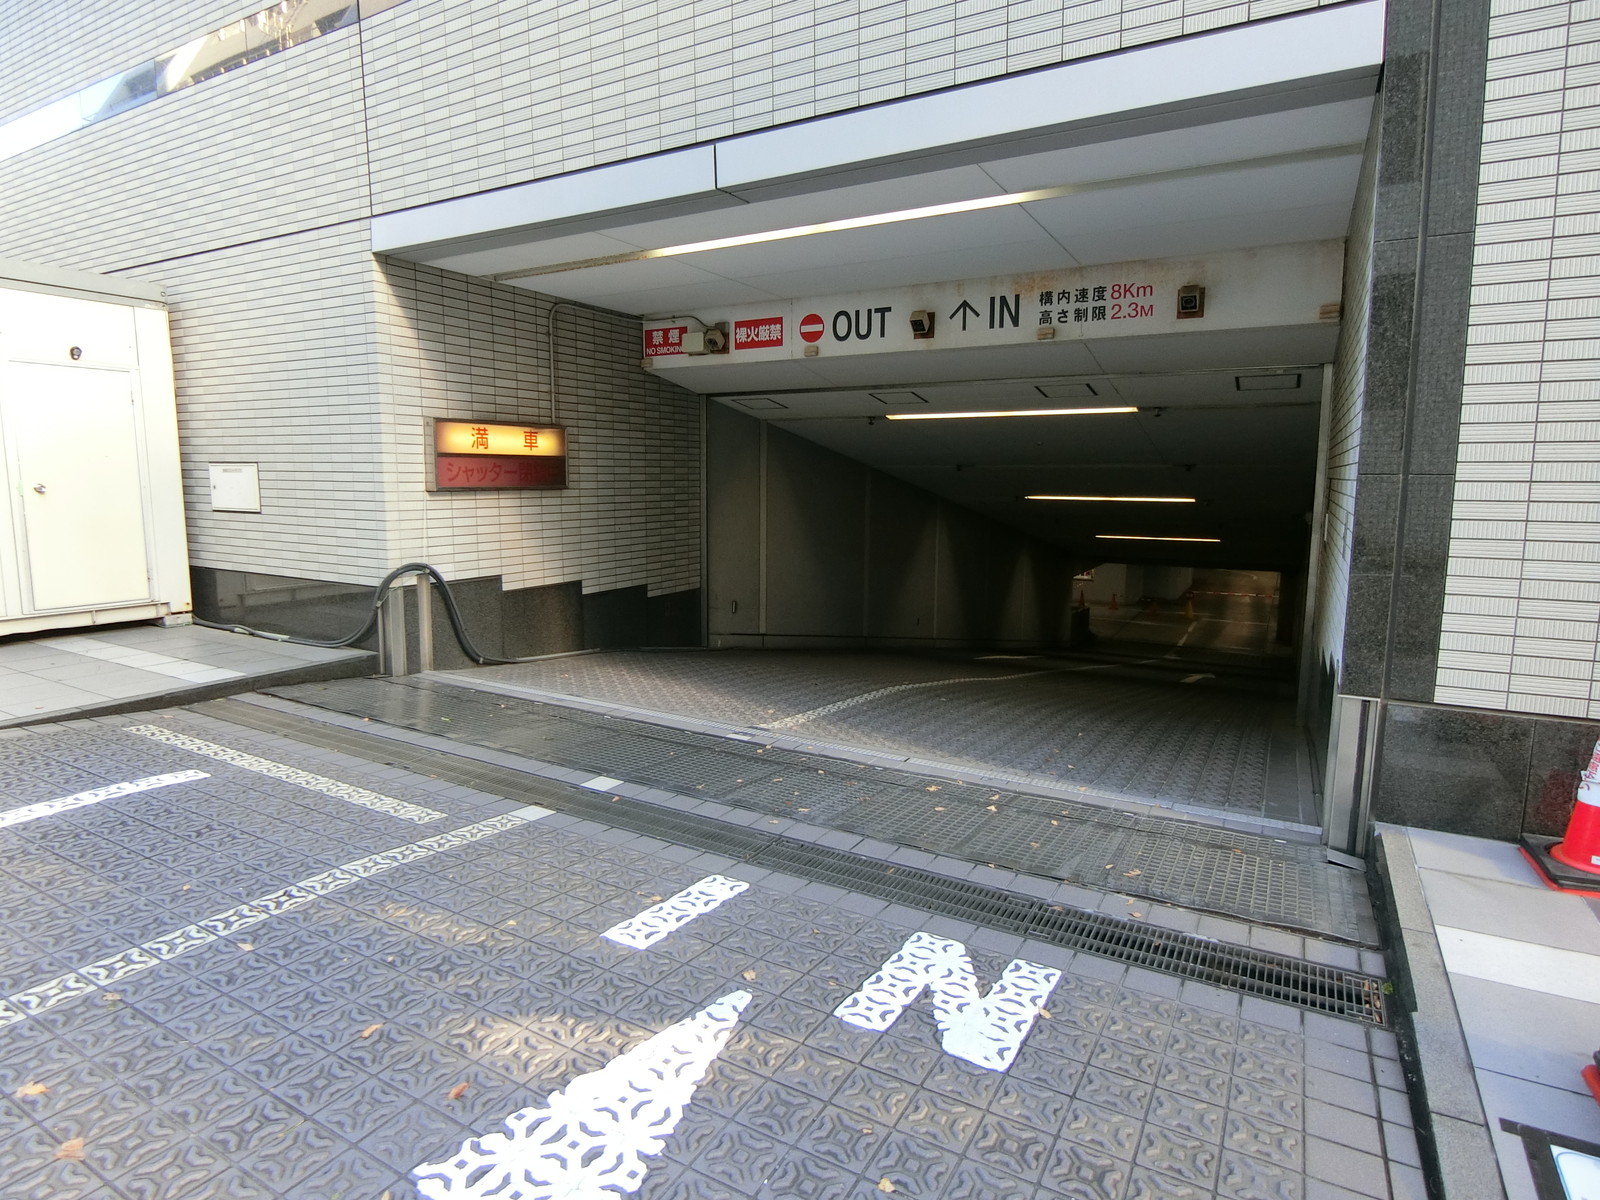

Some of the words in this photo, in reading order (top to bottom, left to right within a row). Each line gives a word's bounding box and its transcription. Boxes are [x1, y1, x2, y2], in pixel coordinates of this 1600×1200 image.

[1039, 286, 1107, 307] 構内速度
[1110, 283, 1153, 300] 8Km
[989, 294, 1020, 329] IN
[1039, 305, 1107, 326] 高さ制限
[736, 323, 782, 344] 裸火厳禁
[832, 306, 892, 342] OUT
[652, 329, 680, 345] 禁煙
[646, 347, 656, 355] NO
[656, 345, 684, 354] SMOKIN
[471, 427, 539, 451] 満車
